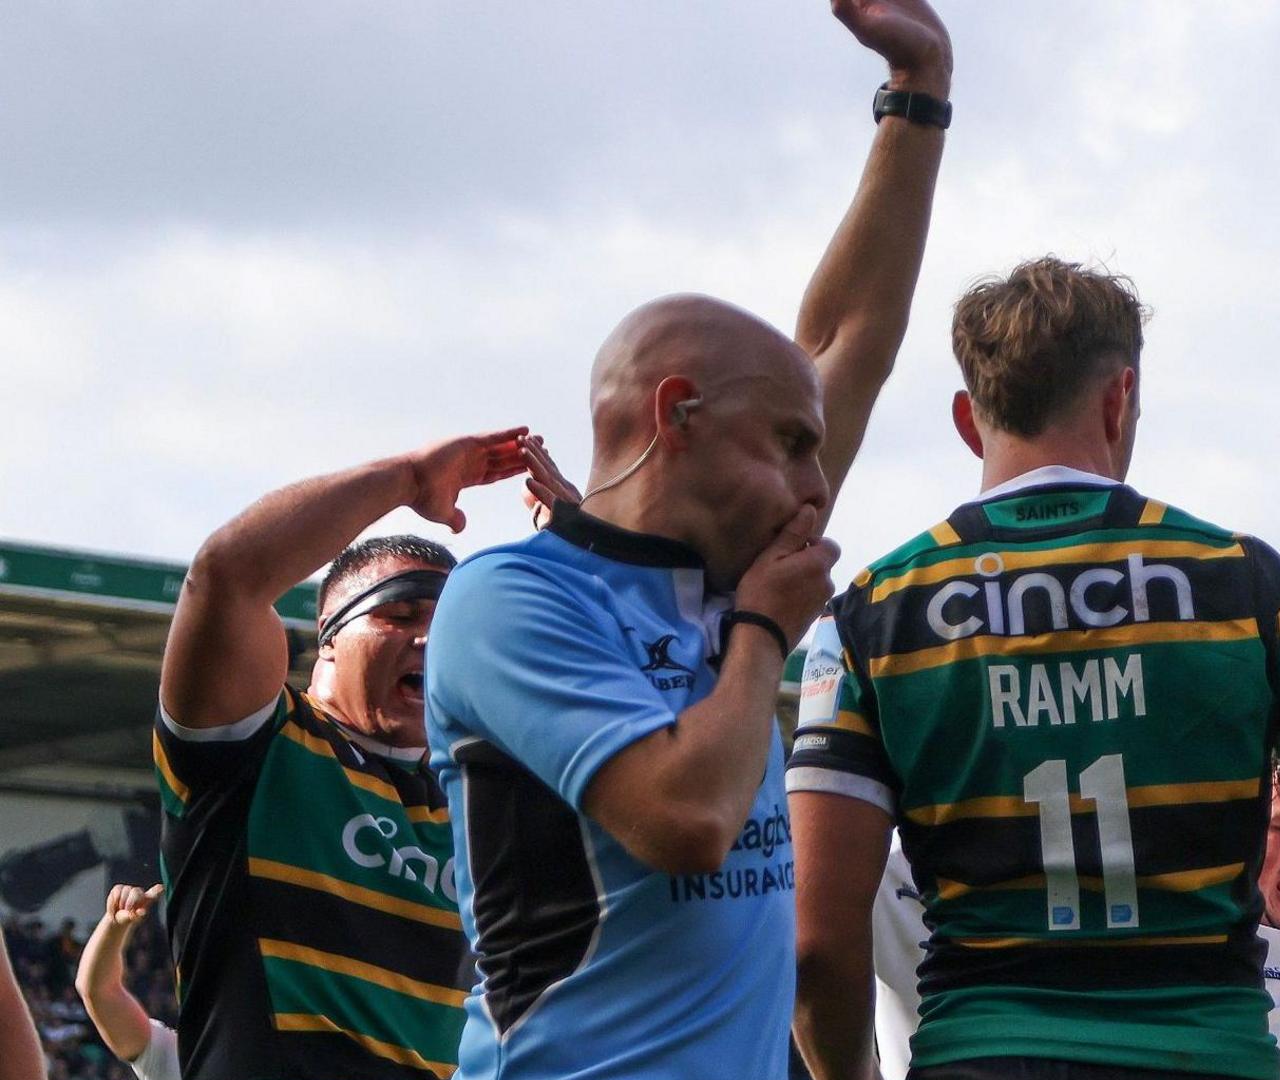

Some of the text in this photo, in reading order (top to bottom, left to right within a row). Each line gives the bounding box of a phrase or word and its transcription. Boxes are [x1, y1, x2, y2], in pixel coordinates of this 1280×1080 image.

[1015, 501, 1080, 522] SAINTS
[926, 552, 1195, 640] cinch
[988, 654, 1147, 729] RAMM
[1023, 754, 1140, 930] 11
[670, 860, 795, 902] INSURANC
